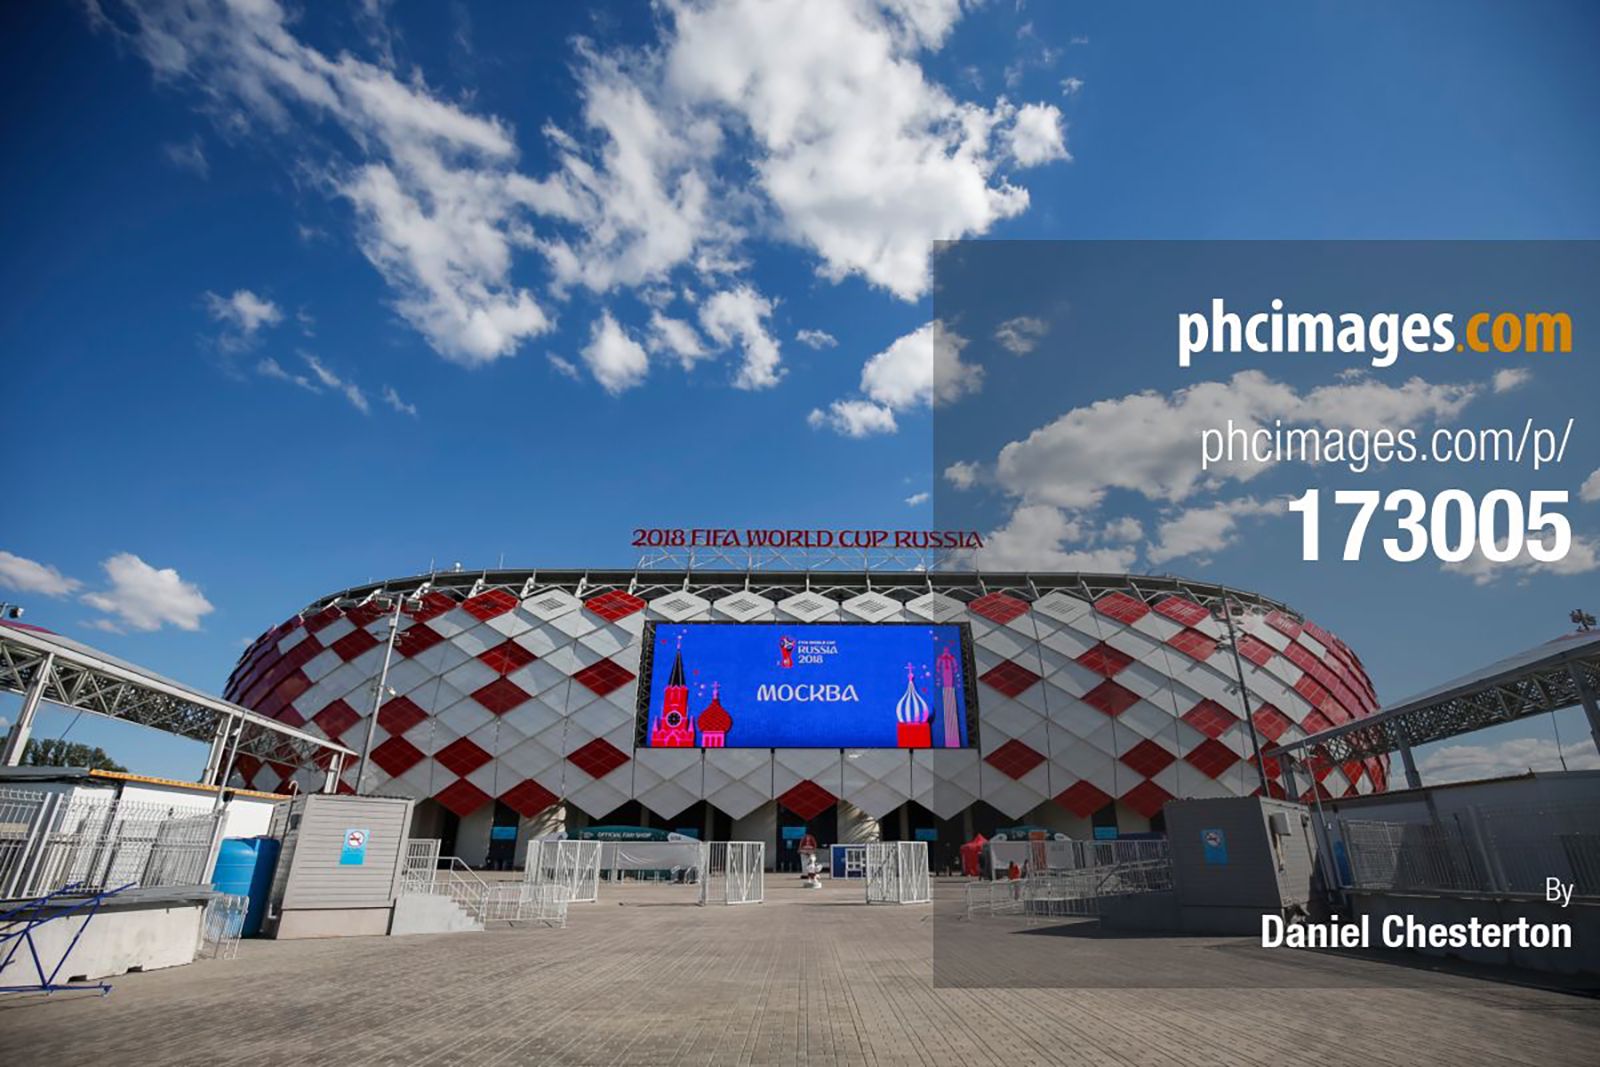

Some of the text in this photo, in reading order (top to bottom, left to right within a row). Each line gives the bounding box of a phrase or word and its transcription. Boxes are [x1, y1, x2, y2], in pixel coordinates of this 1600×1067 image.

[632, 529, 984, 549] 2018 FIFA WORLD CUP RUSSIA
[797, 645, 838, 654] RUSSIA
[798, 654, 824, 664] 2018
[756, 683, 860, 702] МОСКВА
